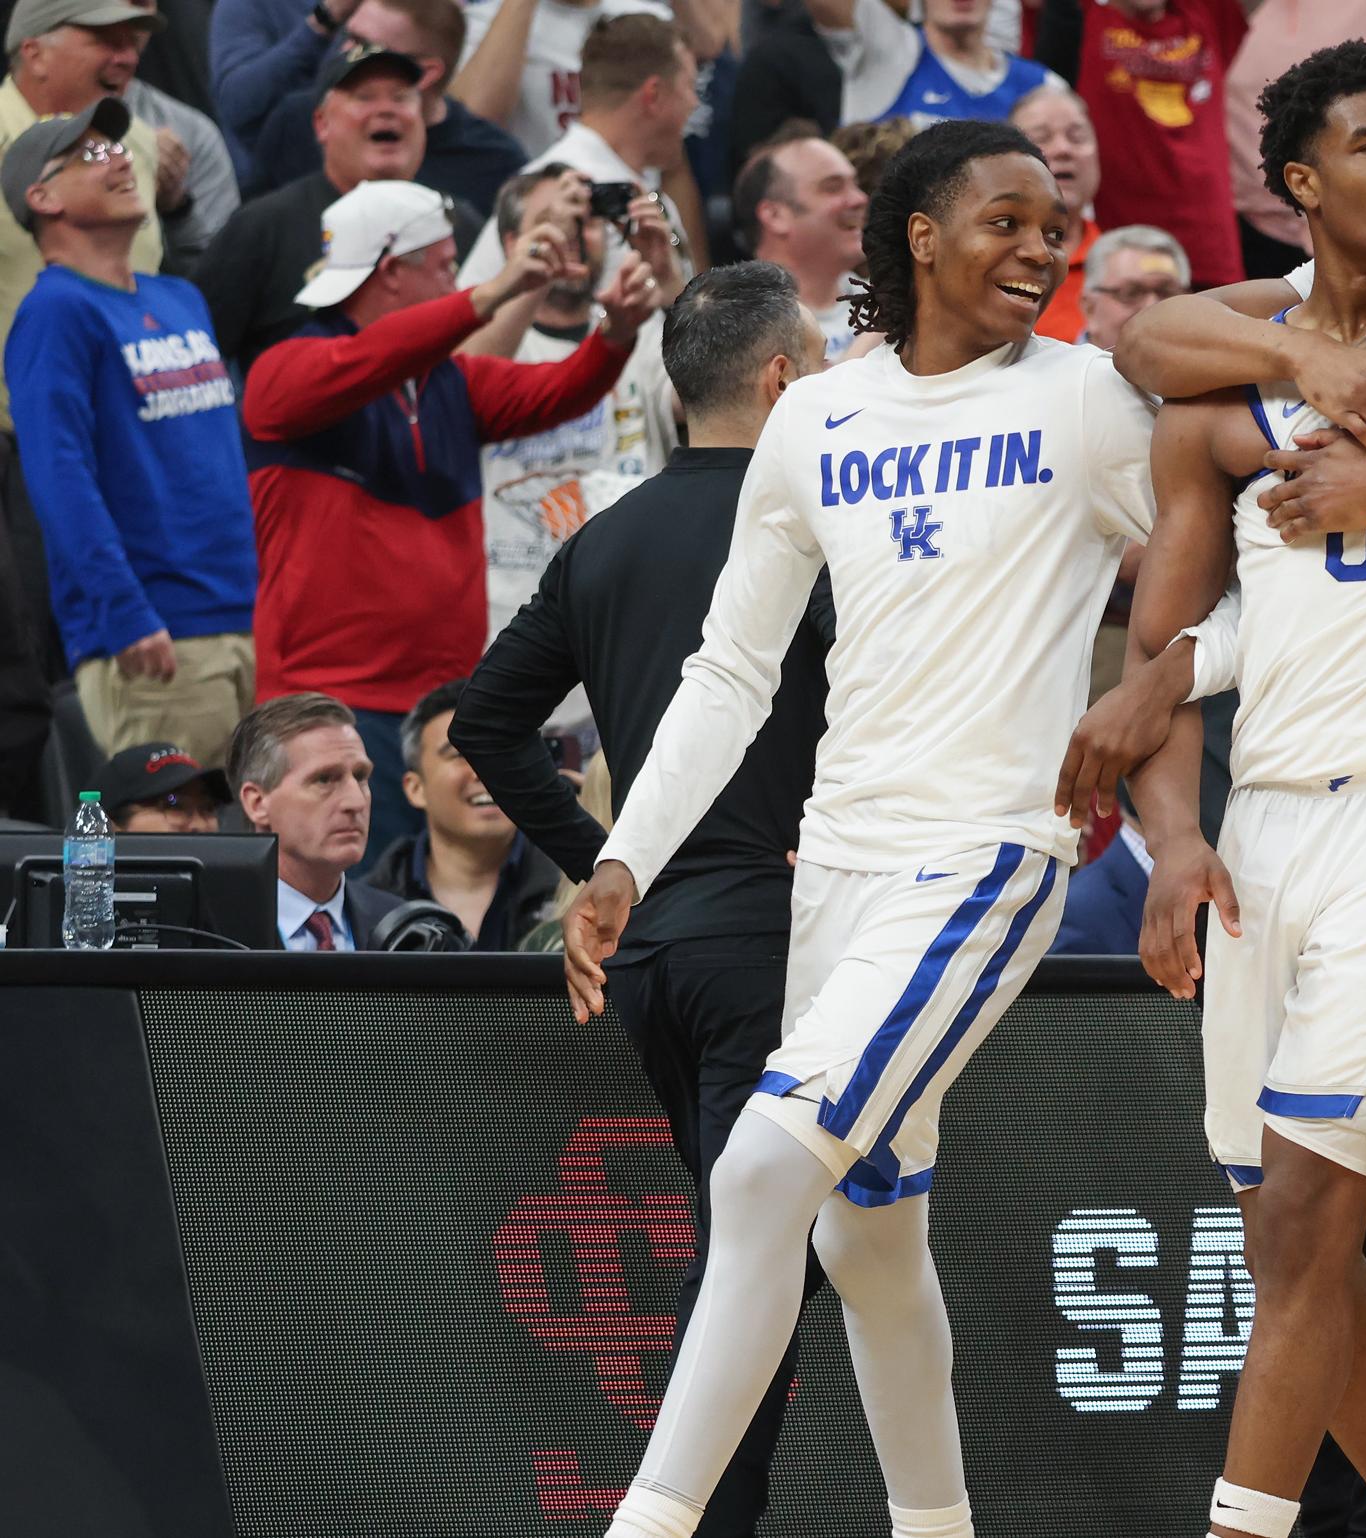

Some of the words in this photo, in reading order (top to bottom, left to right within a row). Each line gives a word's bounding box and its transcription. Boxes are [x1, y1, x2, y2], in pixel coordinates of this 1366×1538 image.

[820, 443, 931, 507] LOCK
[935, 437, 981, 493] IT
[985, 429, 1054, 488] IN.
[889, 505, 944, 562] UK
